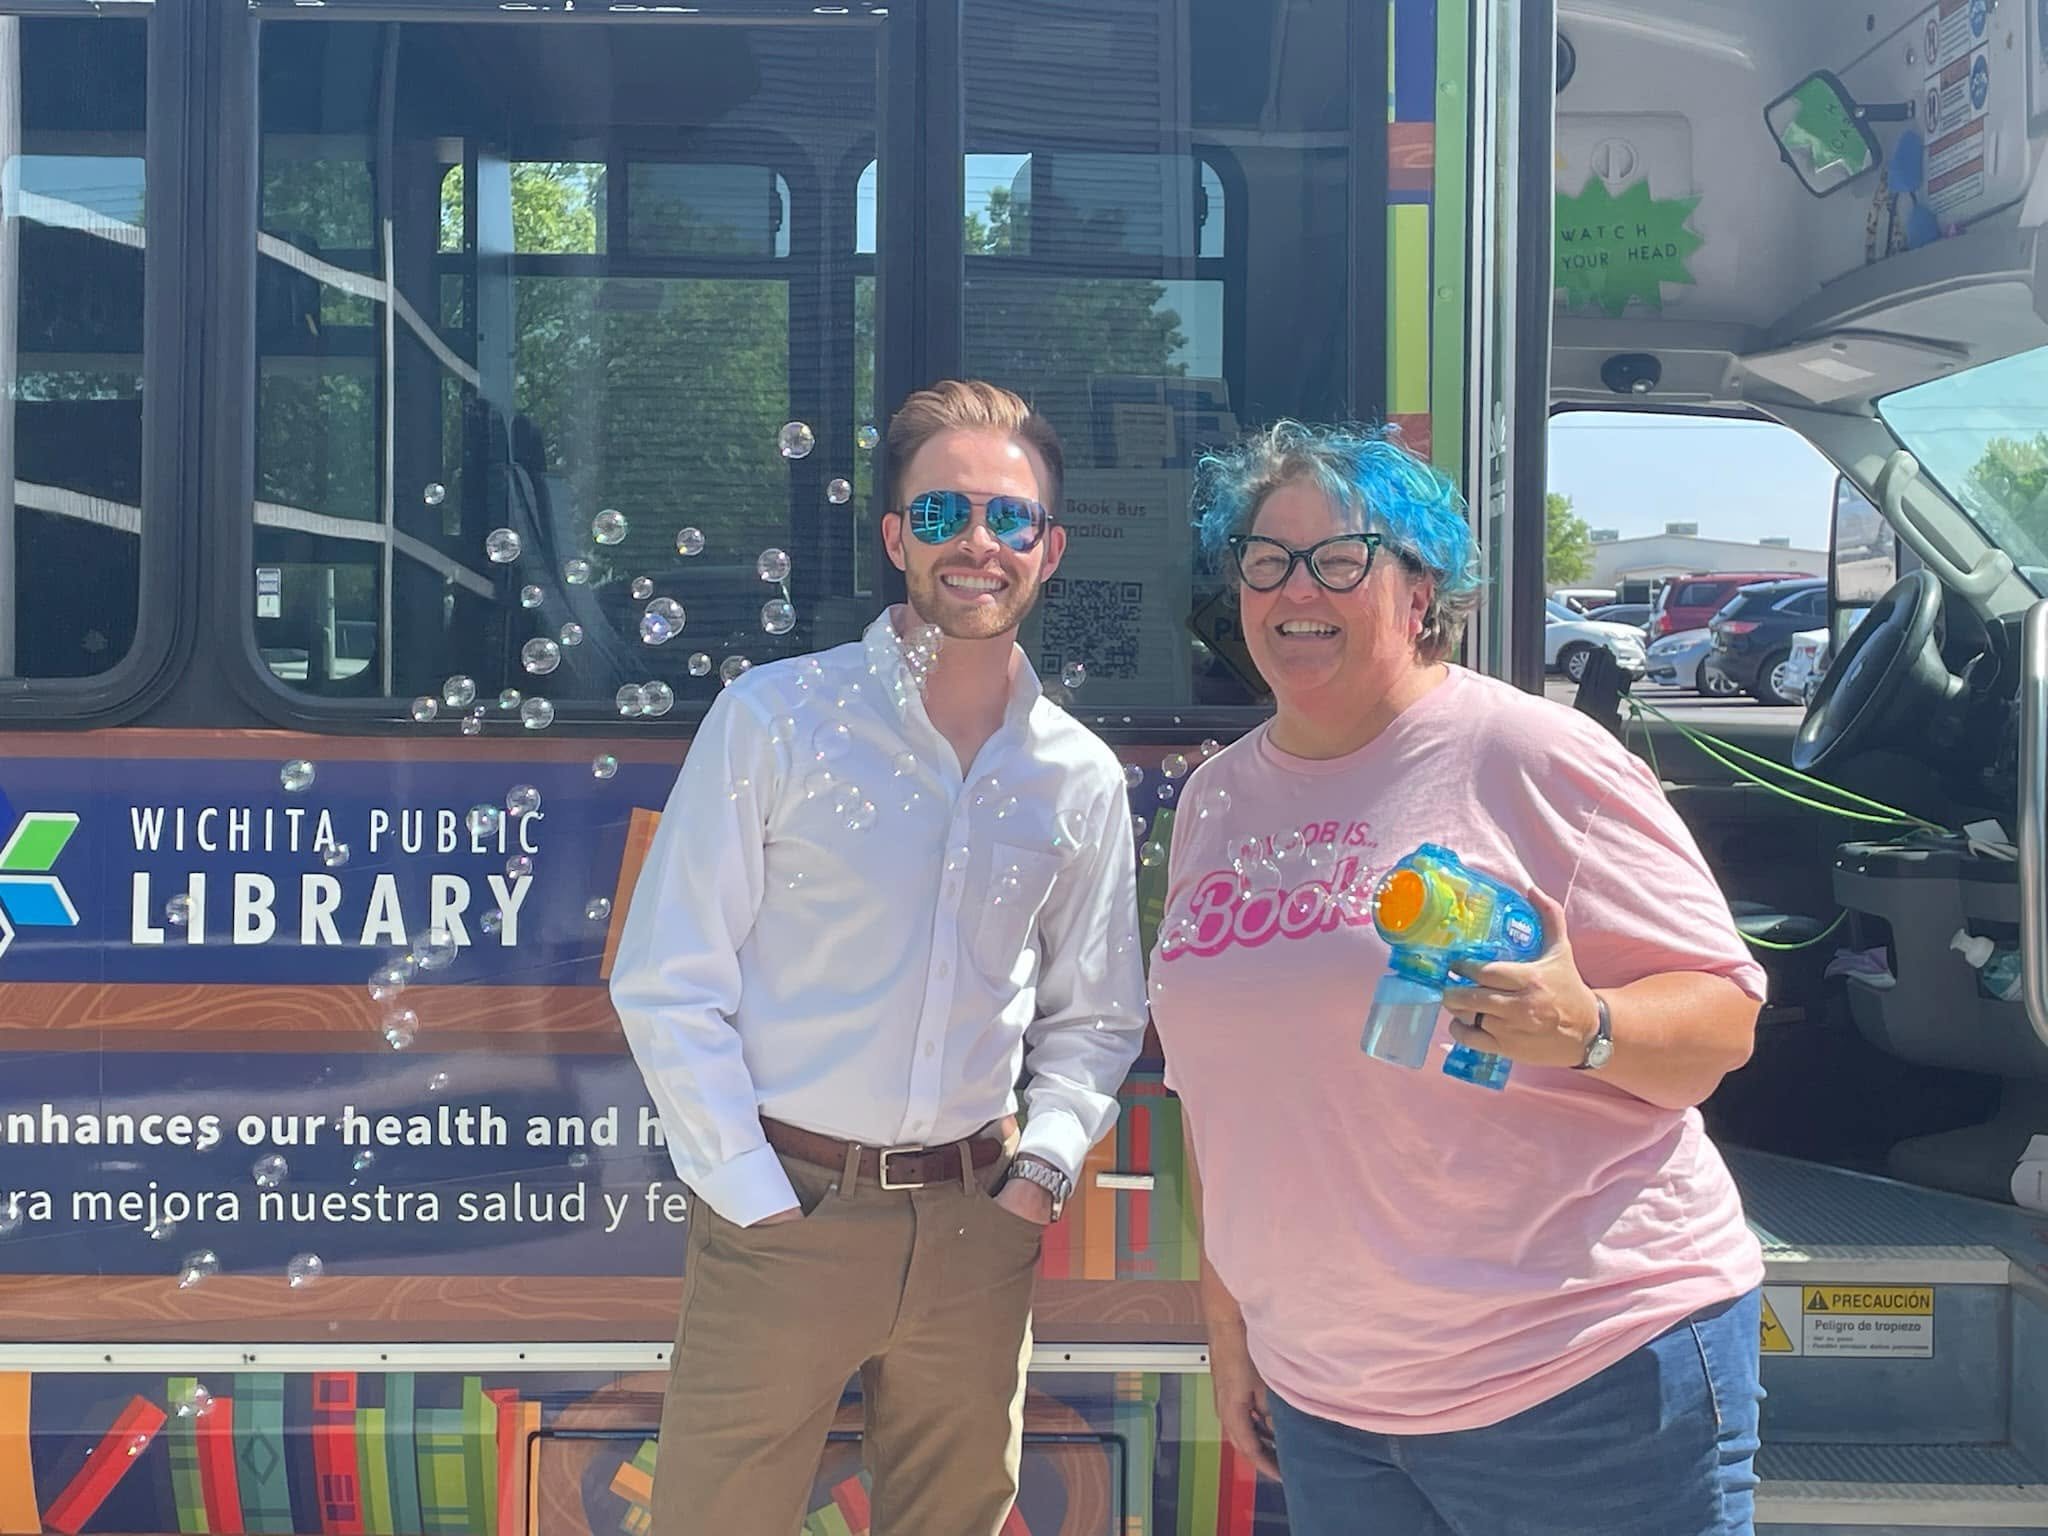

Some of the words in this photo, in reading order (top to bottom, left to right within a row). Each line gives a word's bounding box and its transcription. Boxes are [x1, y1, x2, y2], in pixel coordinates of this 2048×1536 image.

[1560, 223, 1648, 243] WATCH
[1561, 252, 1609, 270] YOUR
[1628, 243, 1678, 262] HEAD
[1065, 498, 1111, 516] Book
[1116, 499, 1147, 518] Bus
[131, 807, 337, 852] WICHITA
[370, 809, 542, 853] PUBLIC
[132, 872, 533, 946] LIBRARY
[1161, 855, 1390, 962] Book
[0, 1103, 221, 1146] nhances
[237, 1115, 326, 1146] our
[342, 1105, 507, 1146] health
[526, 1106, 618, 1146] and
[0, 1191, 52, 1221] ra
[73, 1181, 239, 1232] mejora
[260, 1185, 439, 1222] nuestra
[458, 1182, 585, 1222] salud
[603, 1194, 629, 1233] y
[645, 1182, 688, 1222] fe
[1831, 1290, 1930, 1309] PRECAUCIÓN
[1815, 1319, 1855, 1334] Peligro
[1857, 1319, 1872, 1332] de
[1875, 1320, 1921, 1334] tropiezo
